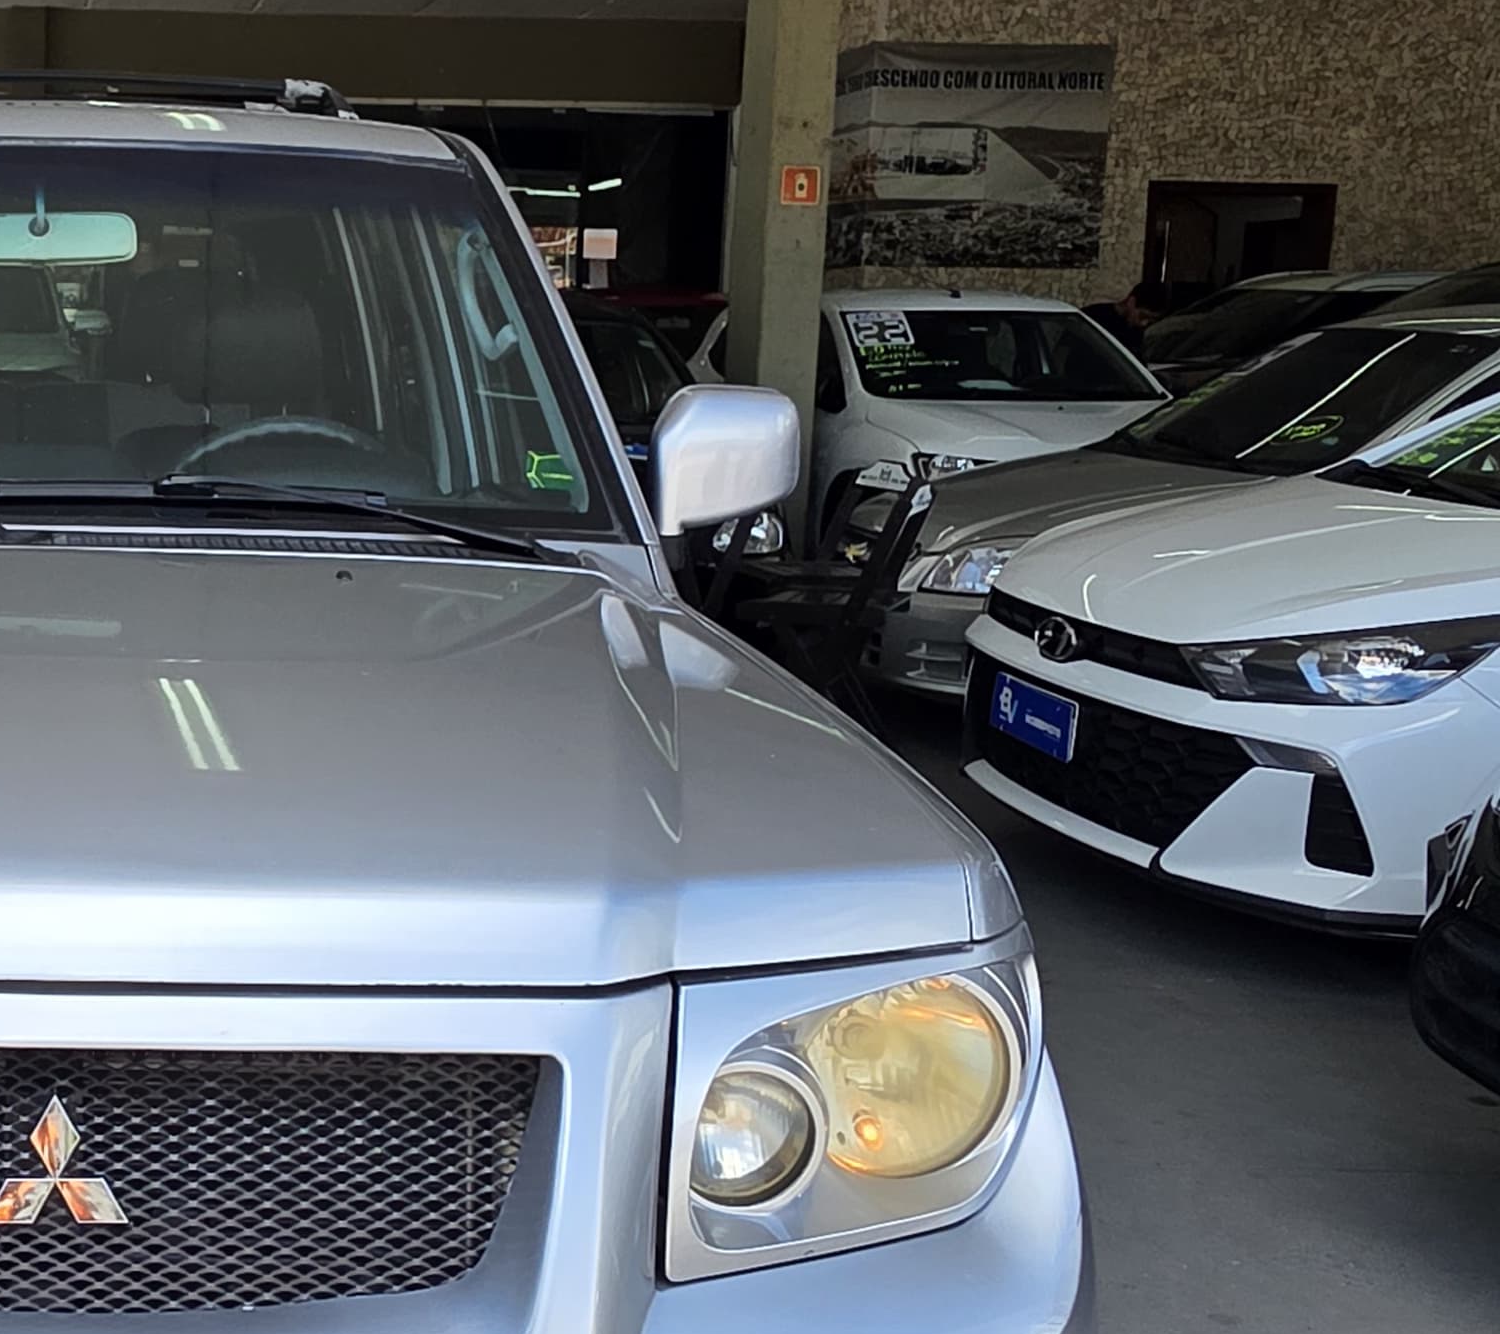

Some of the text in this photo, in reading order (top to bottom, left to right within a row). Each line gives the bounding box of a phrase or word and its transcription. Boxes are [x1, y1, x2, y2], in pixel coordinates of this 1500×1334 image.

[944, 70, 979, 89] COM
[981, 71, 993, 89] O
[995, 71, 1054, 90] LITORAL
[1057, 72, 1105, 90] NORTE
[859, 321, 906, 343] 22
